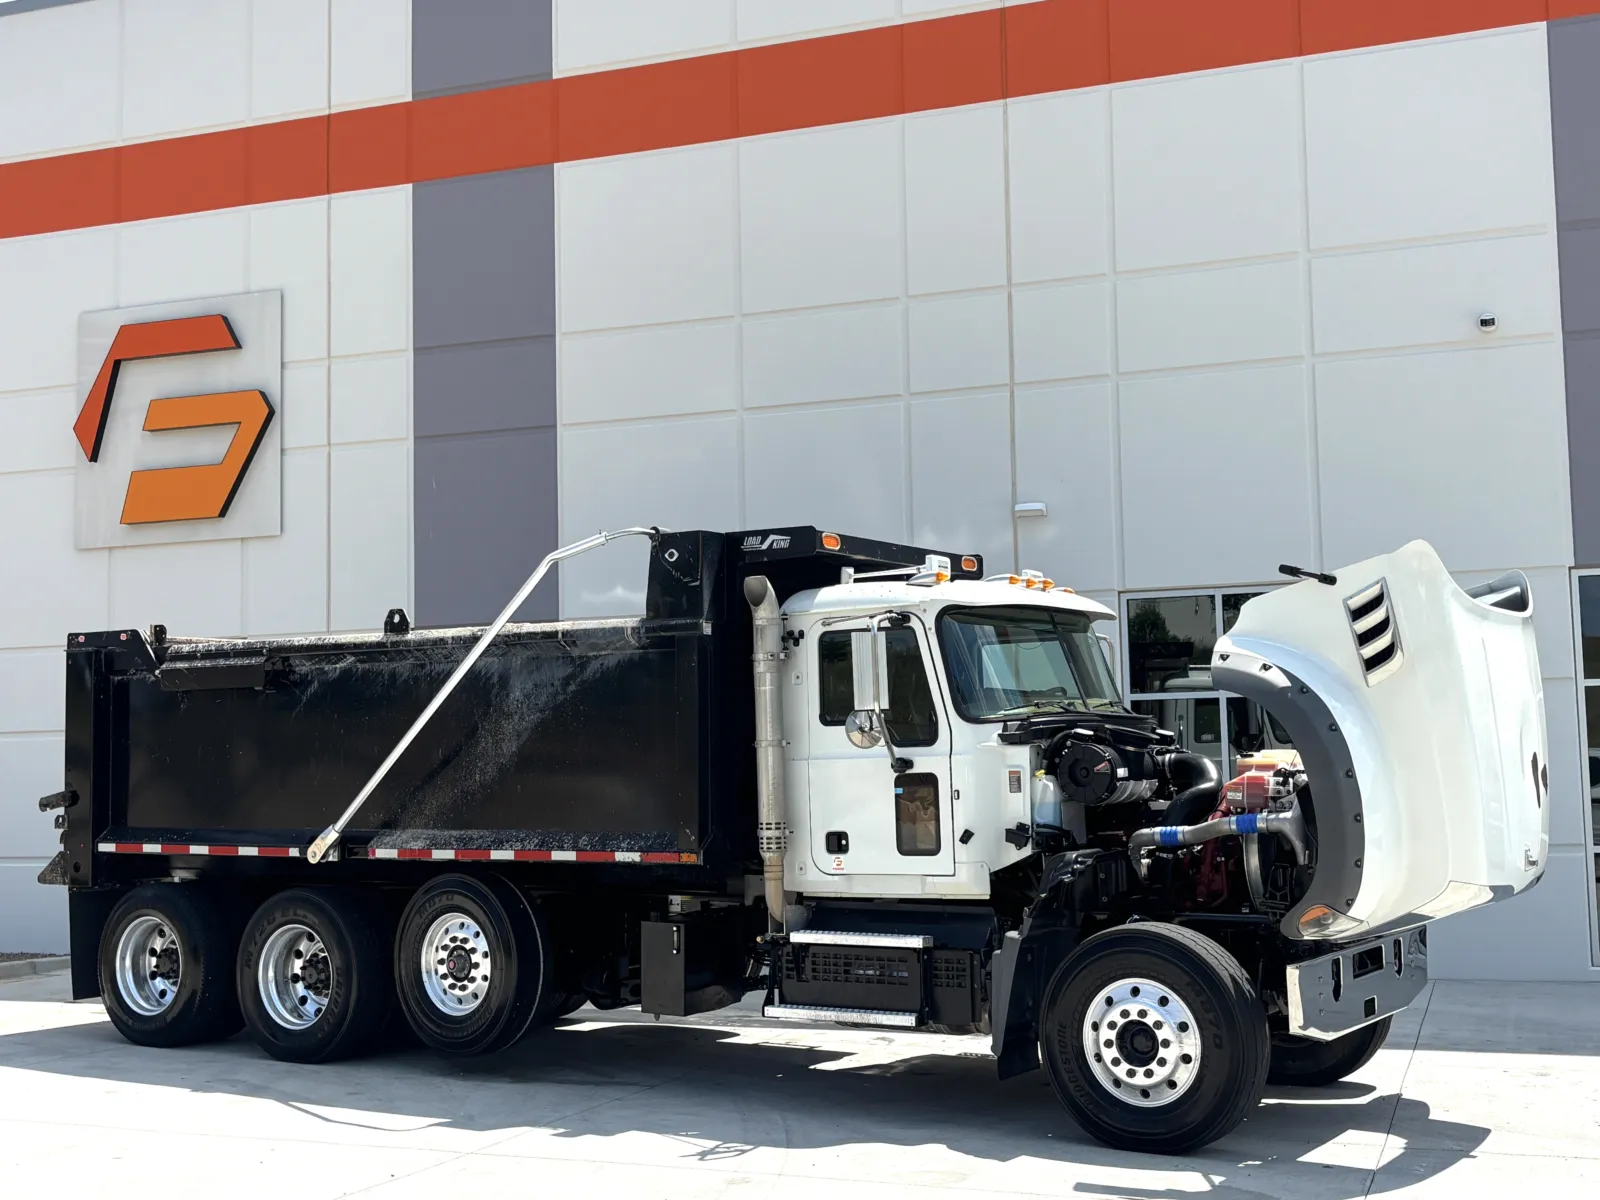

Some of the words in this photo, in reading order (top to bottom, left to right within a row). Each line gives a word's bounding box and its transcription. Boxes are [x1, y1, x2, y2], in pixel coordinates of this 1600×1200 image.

[743, 535, 762, 546] LOAD
[772, 539, 791, 549] KING
[1057, 1019, 1094, 1110] RIDGESTONE
